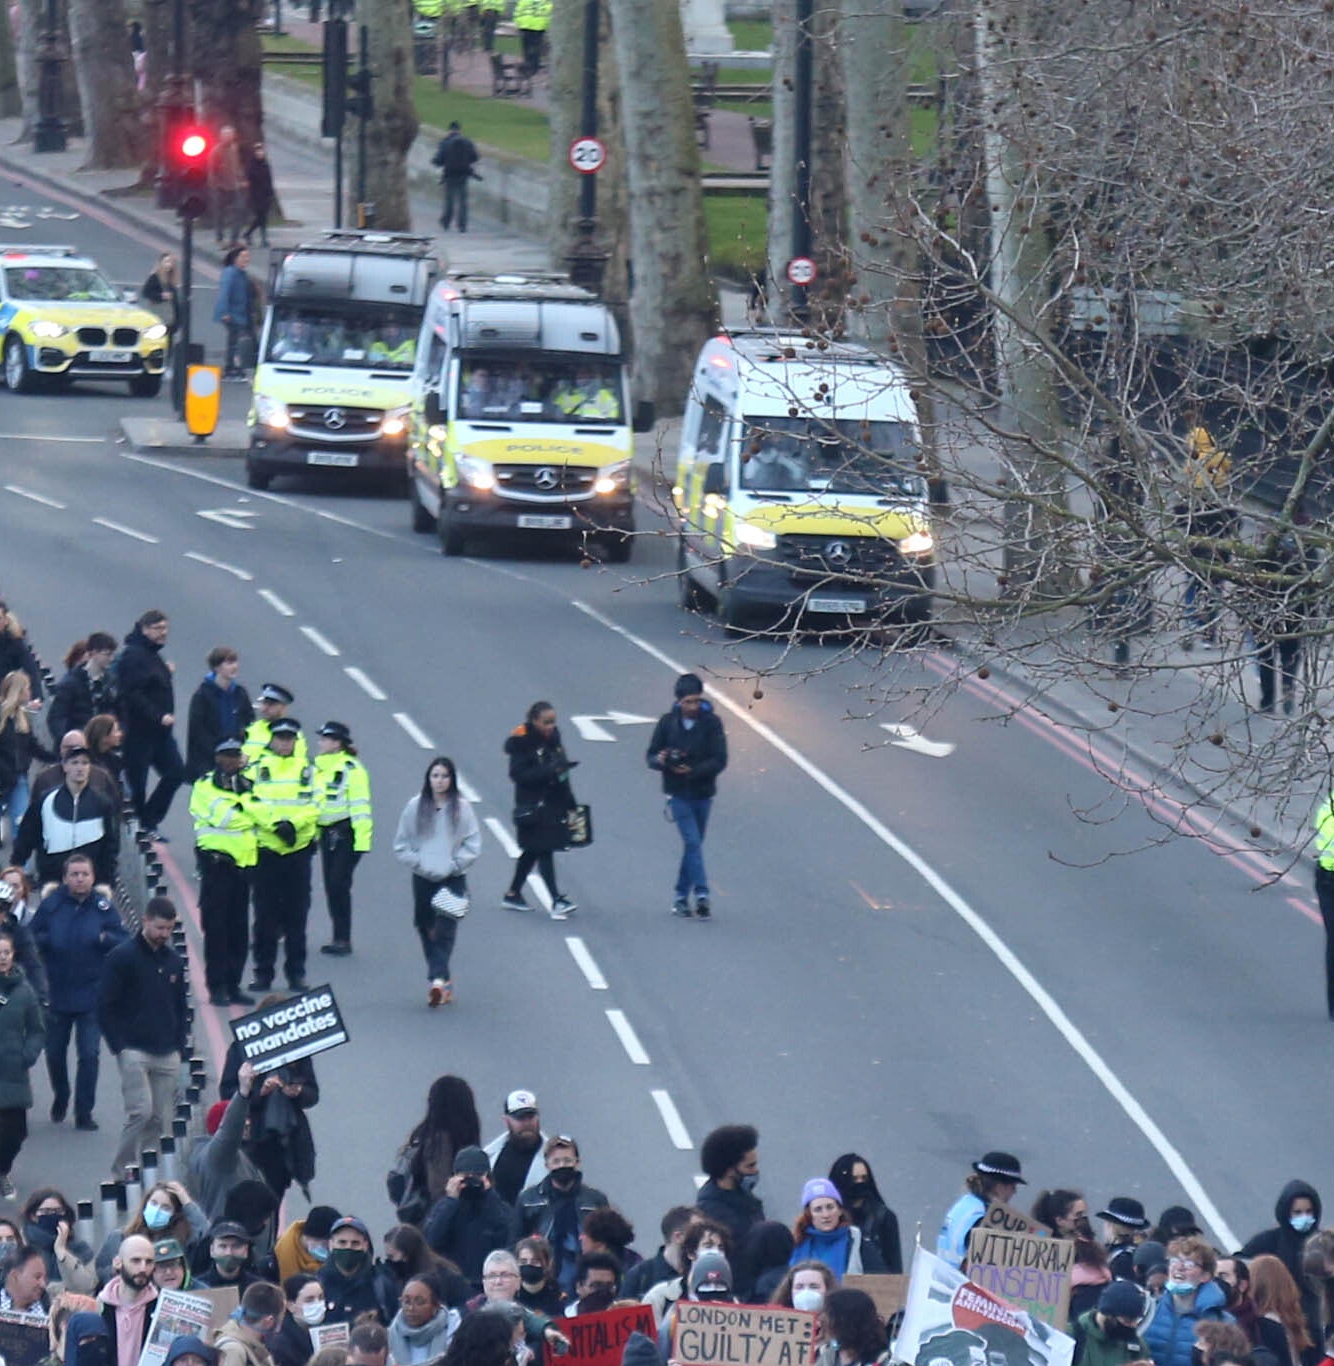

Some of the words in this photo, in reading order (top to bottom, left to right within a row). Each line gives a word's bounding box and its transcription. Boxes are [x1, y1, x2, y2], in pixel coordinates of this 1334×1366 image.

[576, 147, 598, 163] 20
[301, 387, 373, 397] POLICE
[506, 444, 584, 455] POLICE
[236, 1021, 261, 1041] no
[262, 993, 332, 1029] vaccine
[244, 1012, 337, 1058] mandates
[970, 1234, 1073, 1272] WITHDRAW
[546, 1309, 652, 1363] PITALISM
[678, 1307, 753, 1329] LONDON
[679, 1325, 770, 1364] GUILTY
[778, 1340, 811, 1366] AF
